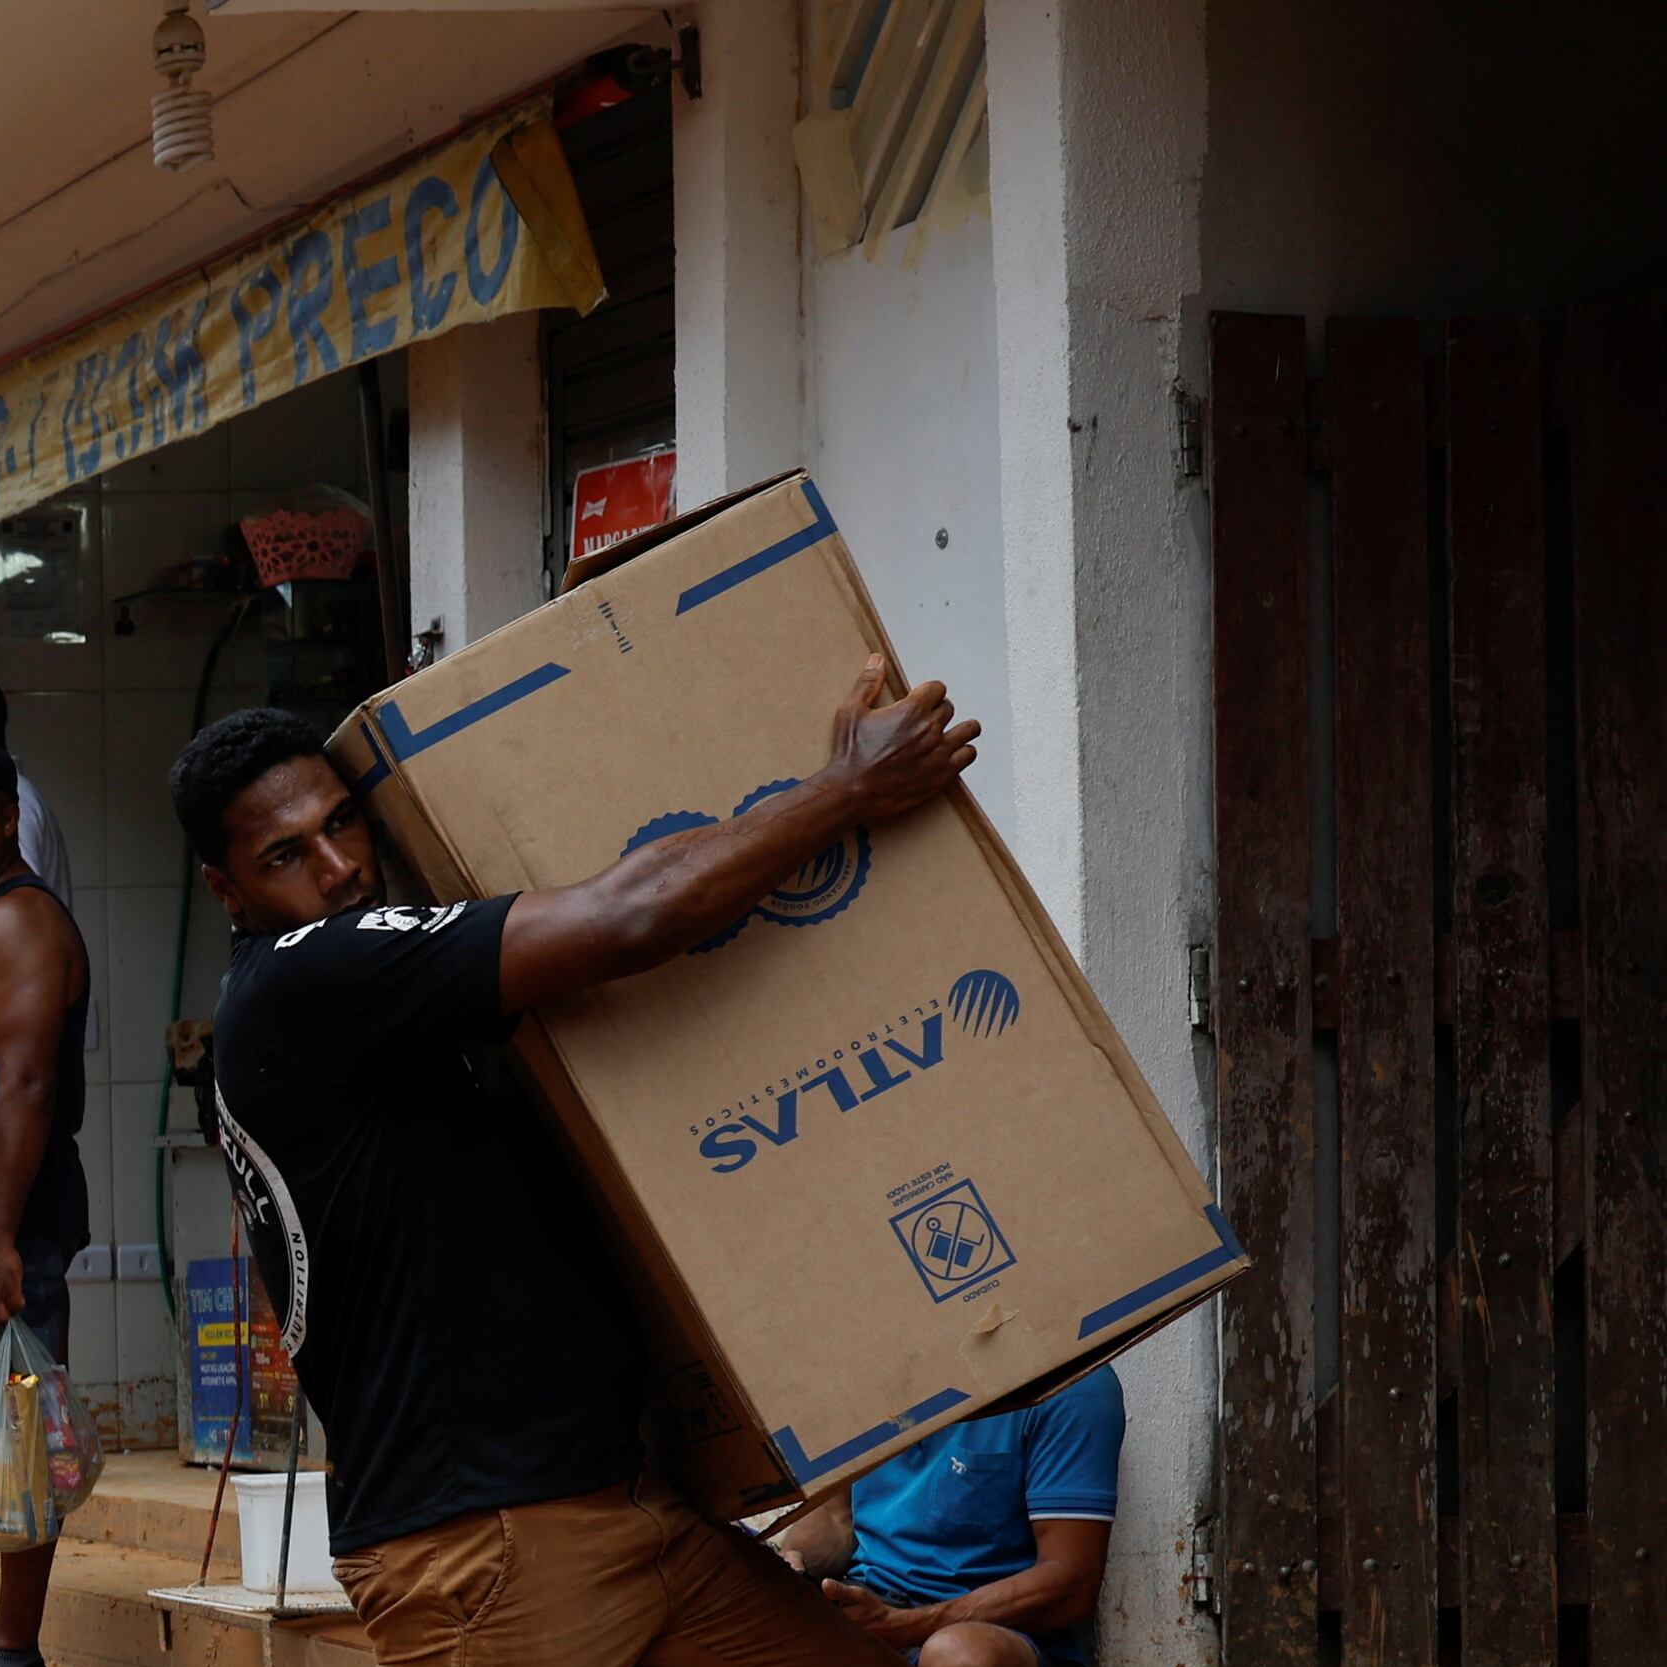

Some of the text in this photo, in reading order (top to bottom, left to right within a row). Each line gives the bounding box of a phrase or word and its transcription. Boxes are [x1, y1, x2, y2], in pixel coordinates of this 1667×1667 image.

[689, 1000, 940, 1134] ELETRODOMÉSTICOS
[698, 1013, 945, 1174] ATLAS
[214, 1286, 244, 1312] CHP
[289, 1231, 306, 1344] NUTRITION
[963, 1280, 999, 1302] CUIDADO
